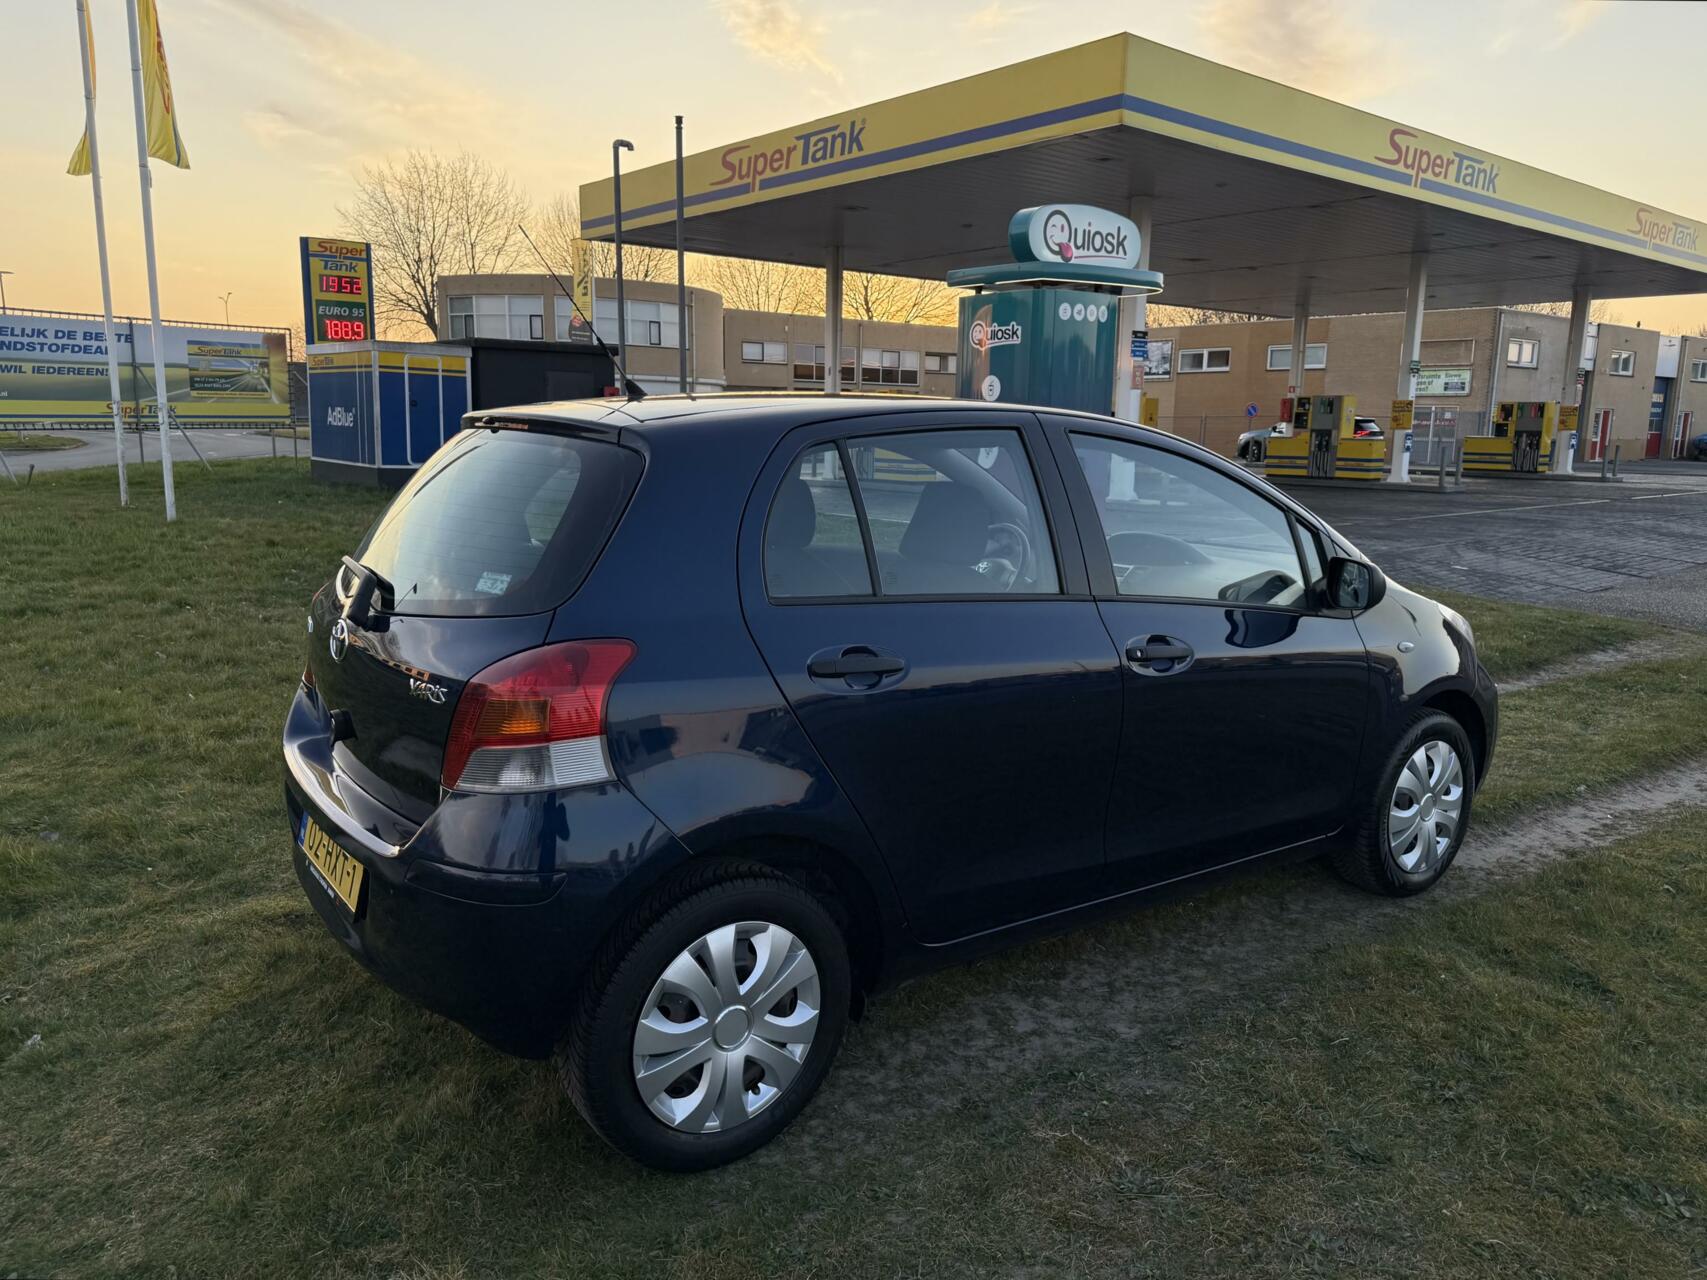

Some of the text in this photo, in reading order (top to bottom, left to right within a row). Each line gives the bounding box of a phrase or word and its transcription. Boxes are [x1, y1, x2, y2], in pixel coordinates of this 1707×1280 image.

[708, 119, 867, 192] SuperTank
[1374, 128, 1499, 193] SuperTank
[1043, 209, 1128, 259] Quiosk
[1627, 208, 1699, 251] SuperTank
[309, 241, 365, 257] Super
[320, 259, 358, 272] Tank
[318, 306, 365, 317] EURO 95
[0, 326, 133, 344] ELIJK DE BETE
[971, 322, 1020, 348] Quiosk
[0, 364, 108, 377] WIL IEDEREEN!
[327, 406, 354, 427] AdBlue
[308, 821, 358, 900] 02-HXT-1
